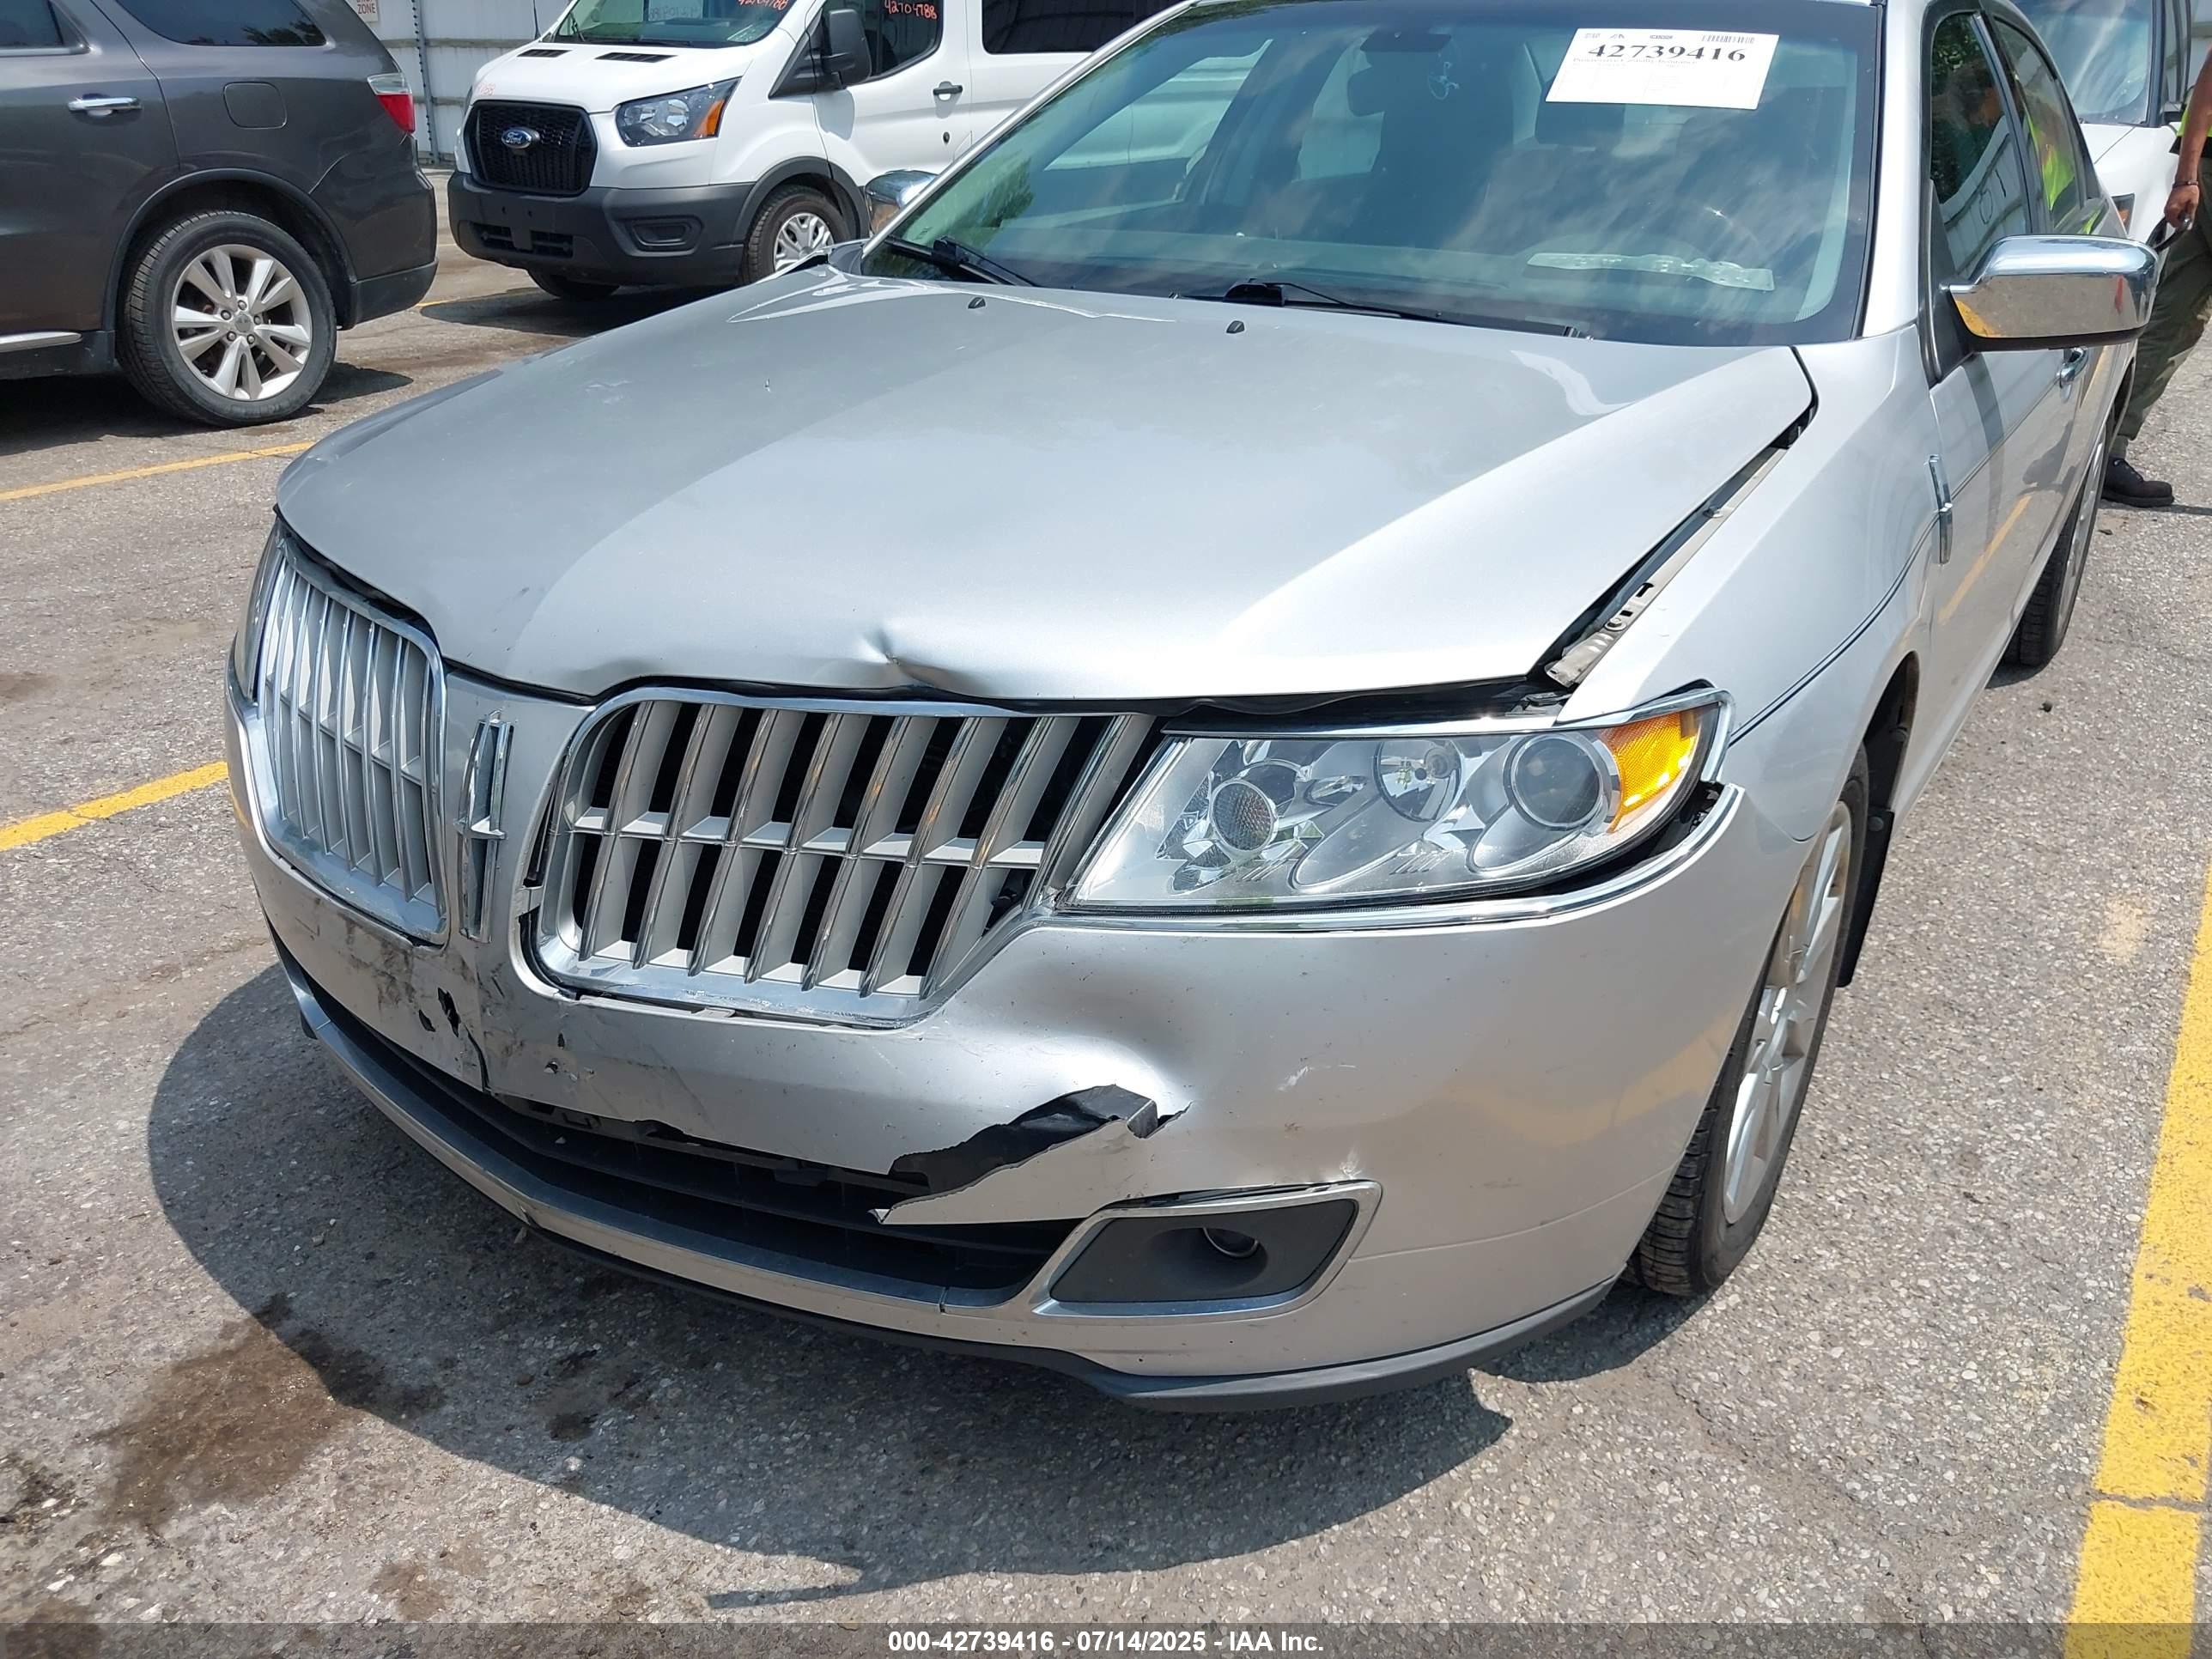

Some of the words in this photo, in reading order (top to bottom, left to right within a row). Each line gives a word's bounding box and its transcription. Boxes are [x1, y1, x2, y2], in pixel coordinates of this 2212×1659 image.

[357, 3, 376, 15] ZONE
[884, 0, 938, 19] 42704788
[1588, 43, 1746, 62] 42739416
